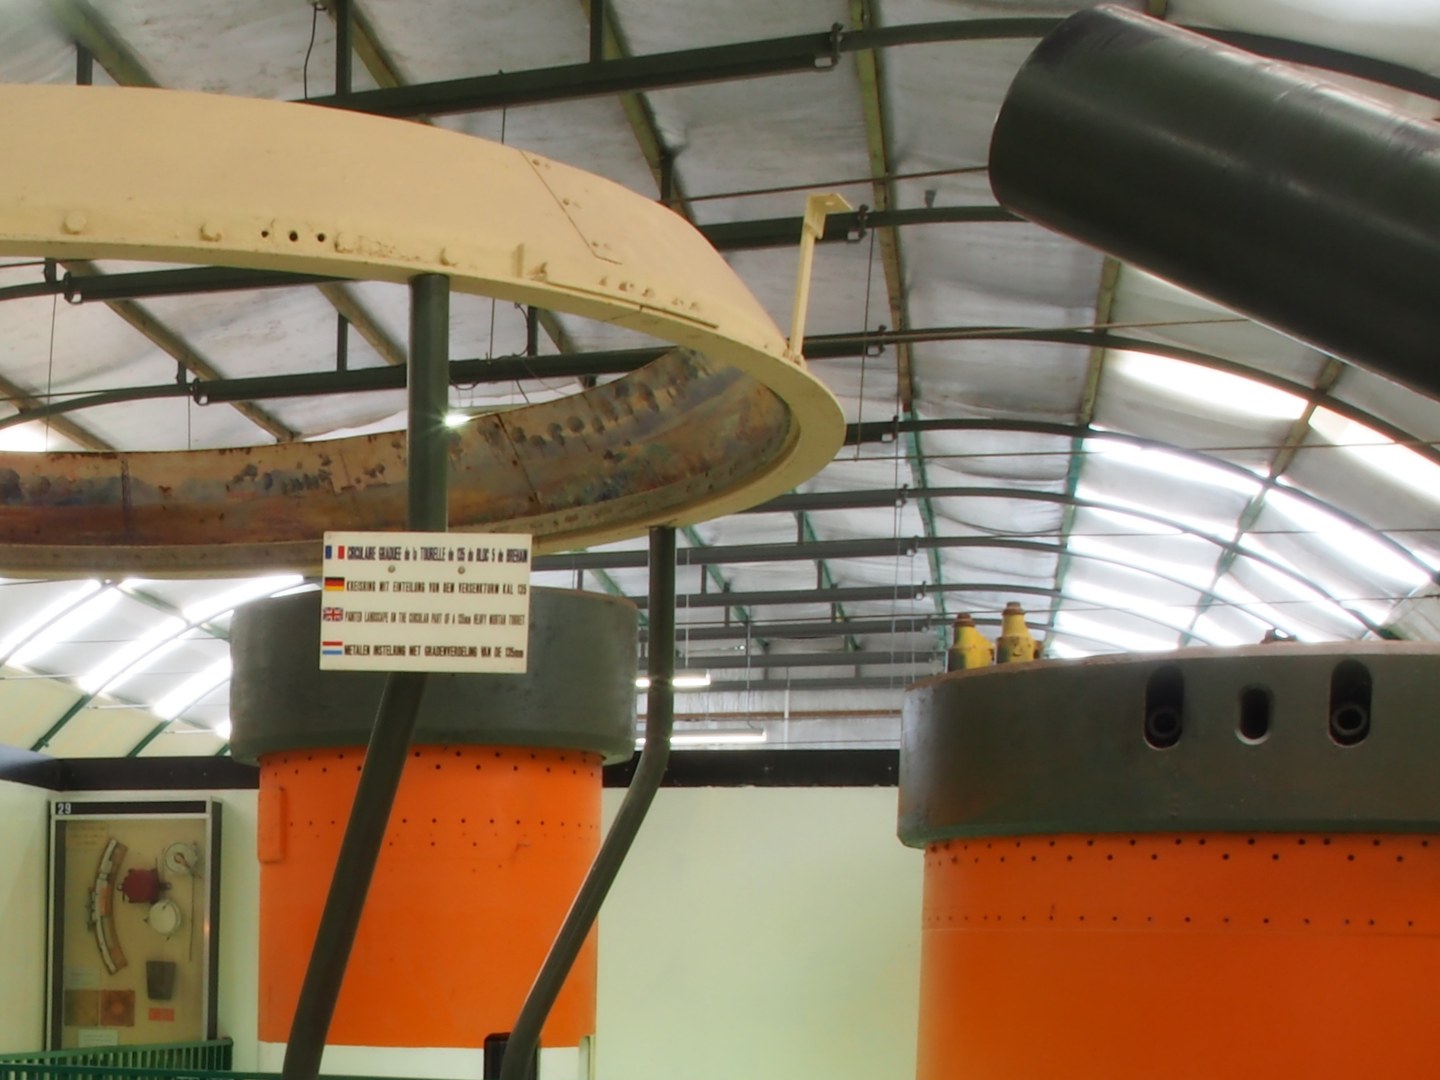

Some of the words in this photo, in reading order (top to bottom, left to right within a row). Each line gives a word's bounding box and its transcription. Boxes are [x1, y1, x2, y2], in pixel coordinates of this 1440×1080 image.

[420, 547, 445, 561] TOURELLE
[379, 582, 389, 592] MIT
[345, 645, 370, 656] METALEN
[409, 645, 421, 656] MET
[58, 803, 71, 815] 29
